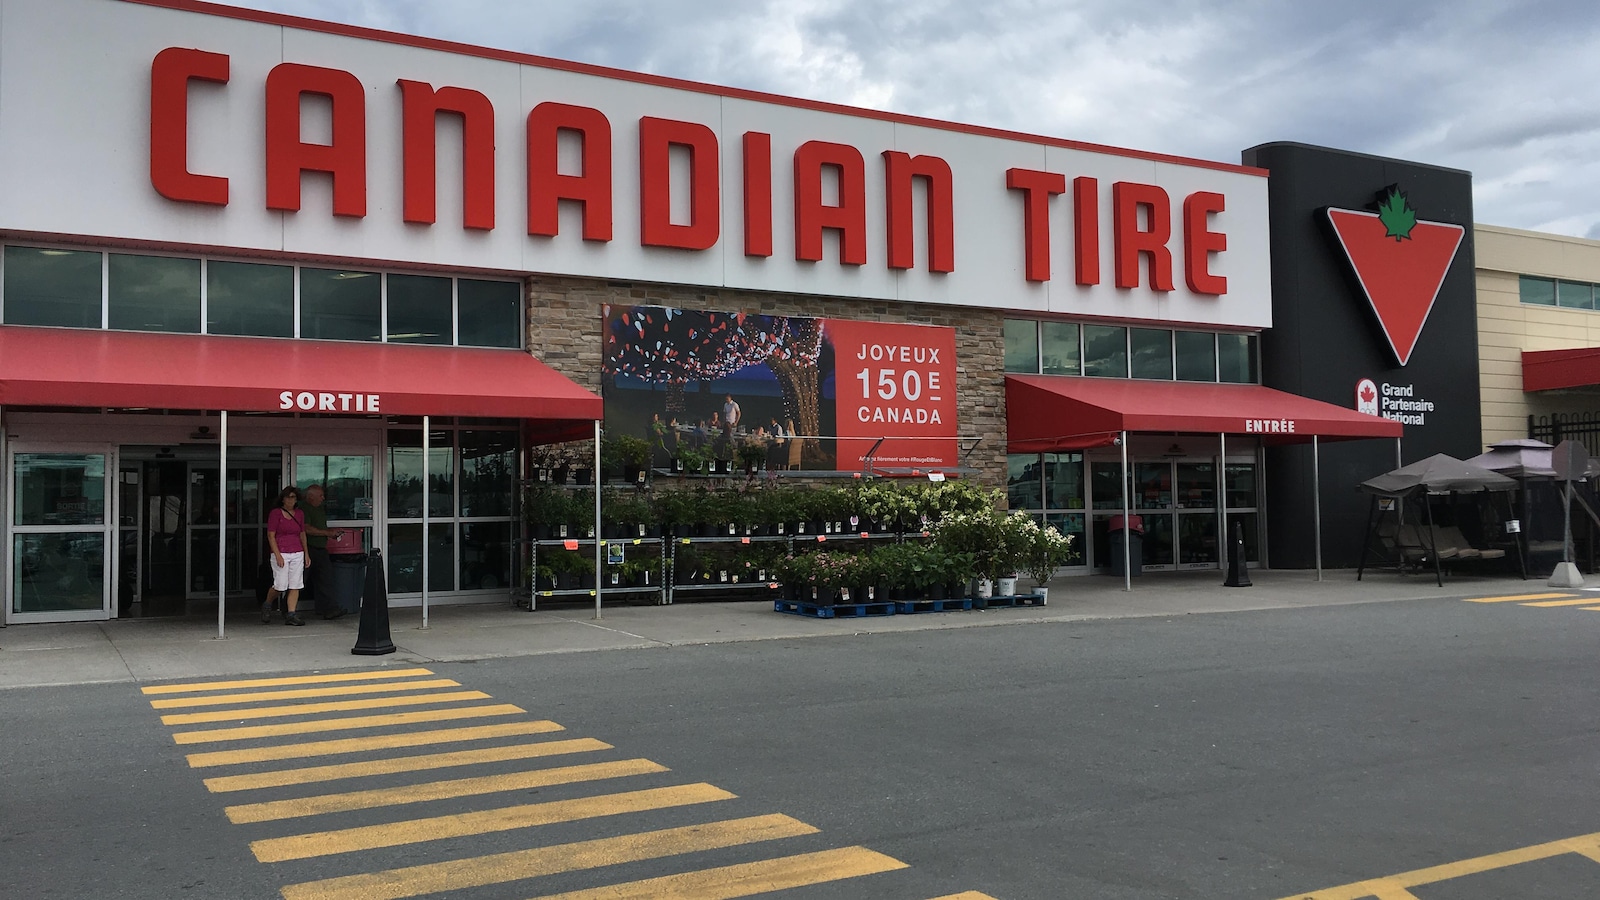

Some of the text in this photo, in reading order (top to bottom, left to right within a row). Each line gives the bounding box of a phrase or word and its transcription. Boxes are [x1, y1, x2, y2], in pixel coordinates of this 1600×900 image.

[150, 46, 1228, 296] CANADIAN TIRE
[857, 343, 941, 364] JOYEUX
[1381, 382, 1414, 397] Grand
[279, 391, 380, 412] SORTIE
[1382, 396, 1435, 412] Partenaire
[857, 406, 942, 424] CANADA
[1382, 410, 1425, 425] National
[1245, 418, 1295, 433] ENTRÉE
